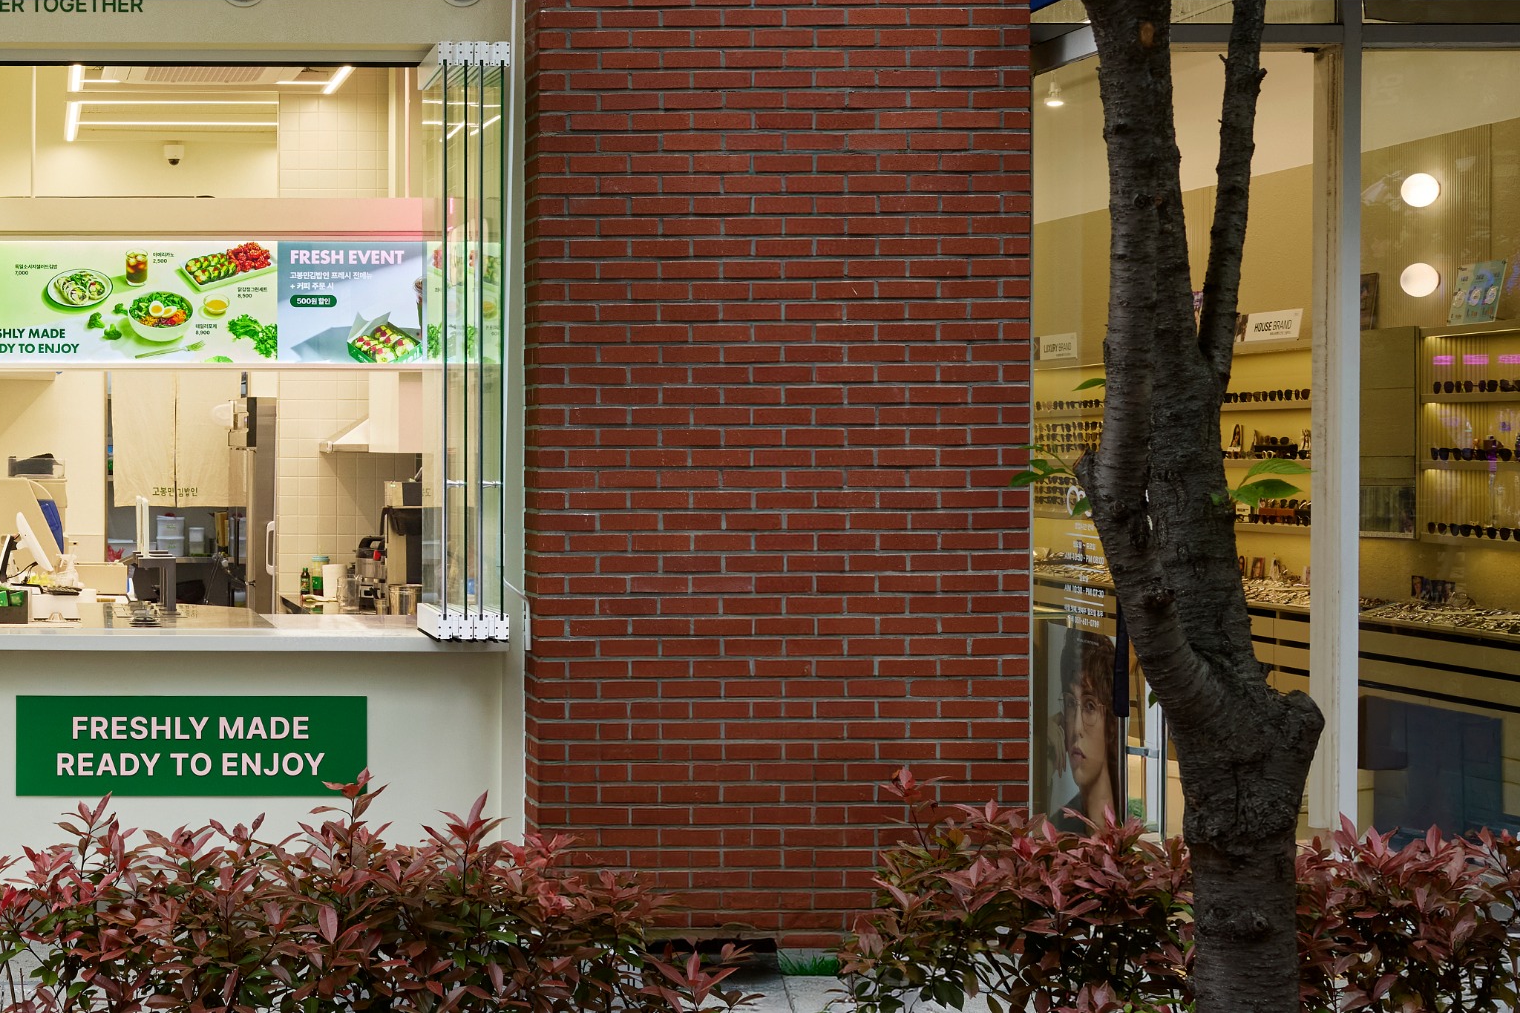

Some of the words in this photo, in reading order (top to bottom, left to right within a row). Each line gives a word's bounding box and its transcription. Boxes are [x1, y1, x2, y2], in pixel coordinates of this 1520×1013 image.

[34, 0, 144, 13] TOGETHER
[290, 249, 344, 265] FRESH
[348, 249, 405, 265] EVENT
[289, 271, 330, 280] 고봉민김밥인
[331, 271, 352, 280] 프레시
[296, 282, 311, 291] 커피
[296, 297, 318, 305] 500원
[1254, 321, 1273, 333] HOUSE
[1272, 319, 1293, 331] BRAND
[28, 328, 66, 339] MADE
[18, 343, 36, 354] TO
[38, 343, 80, 354] ENJOY
[152, 486, 175, 497] 고봉민
[177, 487, 198, 498] 김밥인
[71, 715, 211, 740] FRESHLY
[218, 715, 310, 740] MADE
[55, 752, 162, 777] READY
[169, 752, 213, 777] TO
[221, 752, 326, 777] ENJOY
